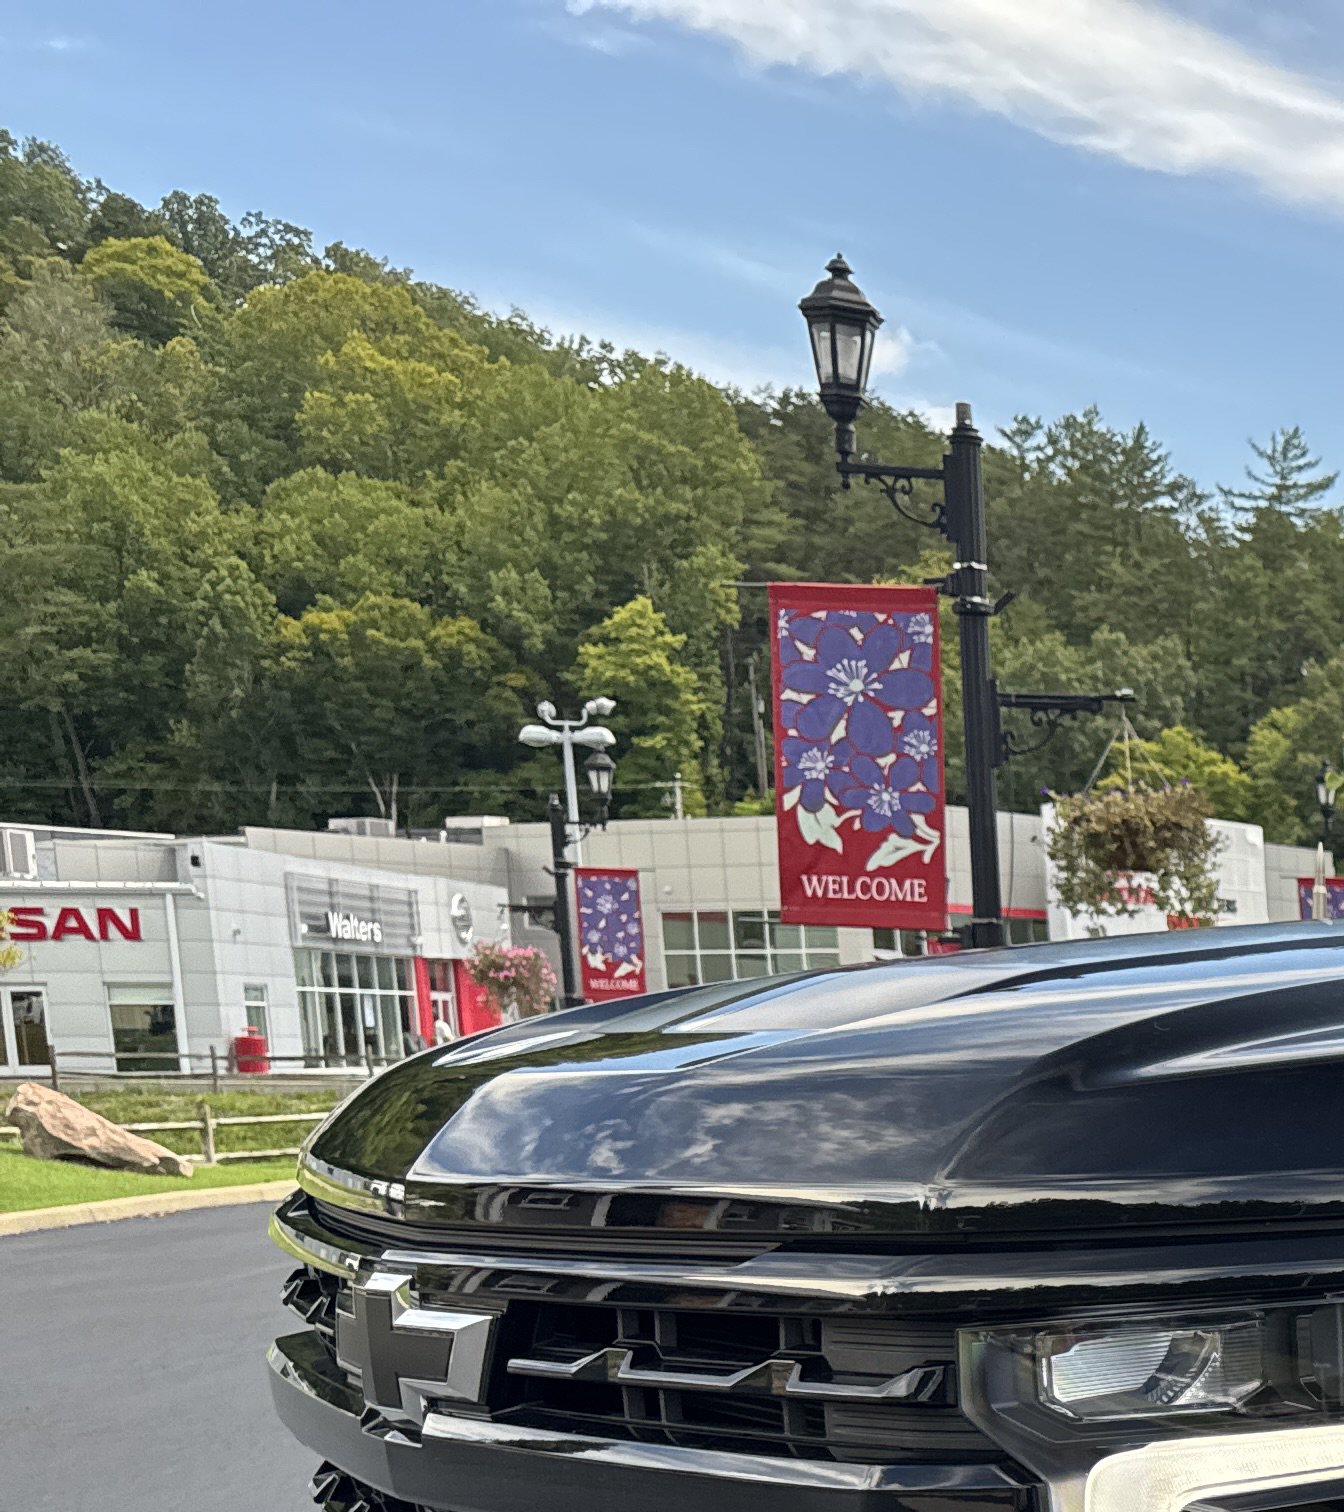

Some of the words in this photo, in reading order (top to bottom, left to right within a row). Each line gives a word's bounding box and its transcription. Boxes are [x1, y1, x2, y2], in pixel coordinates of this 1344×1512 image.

[800, 874, 927, 902] WELCOME
[1, 906, 142, 942] SAN
[327, 910, 382, 942] Walters
[589, 978, 639, 991] WELCOME
